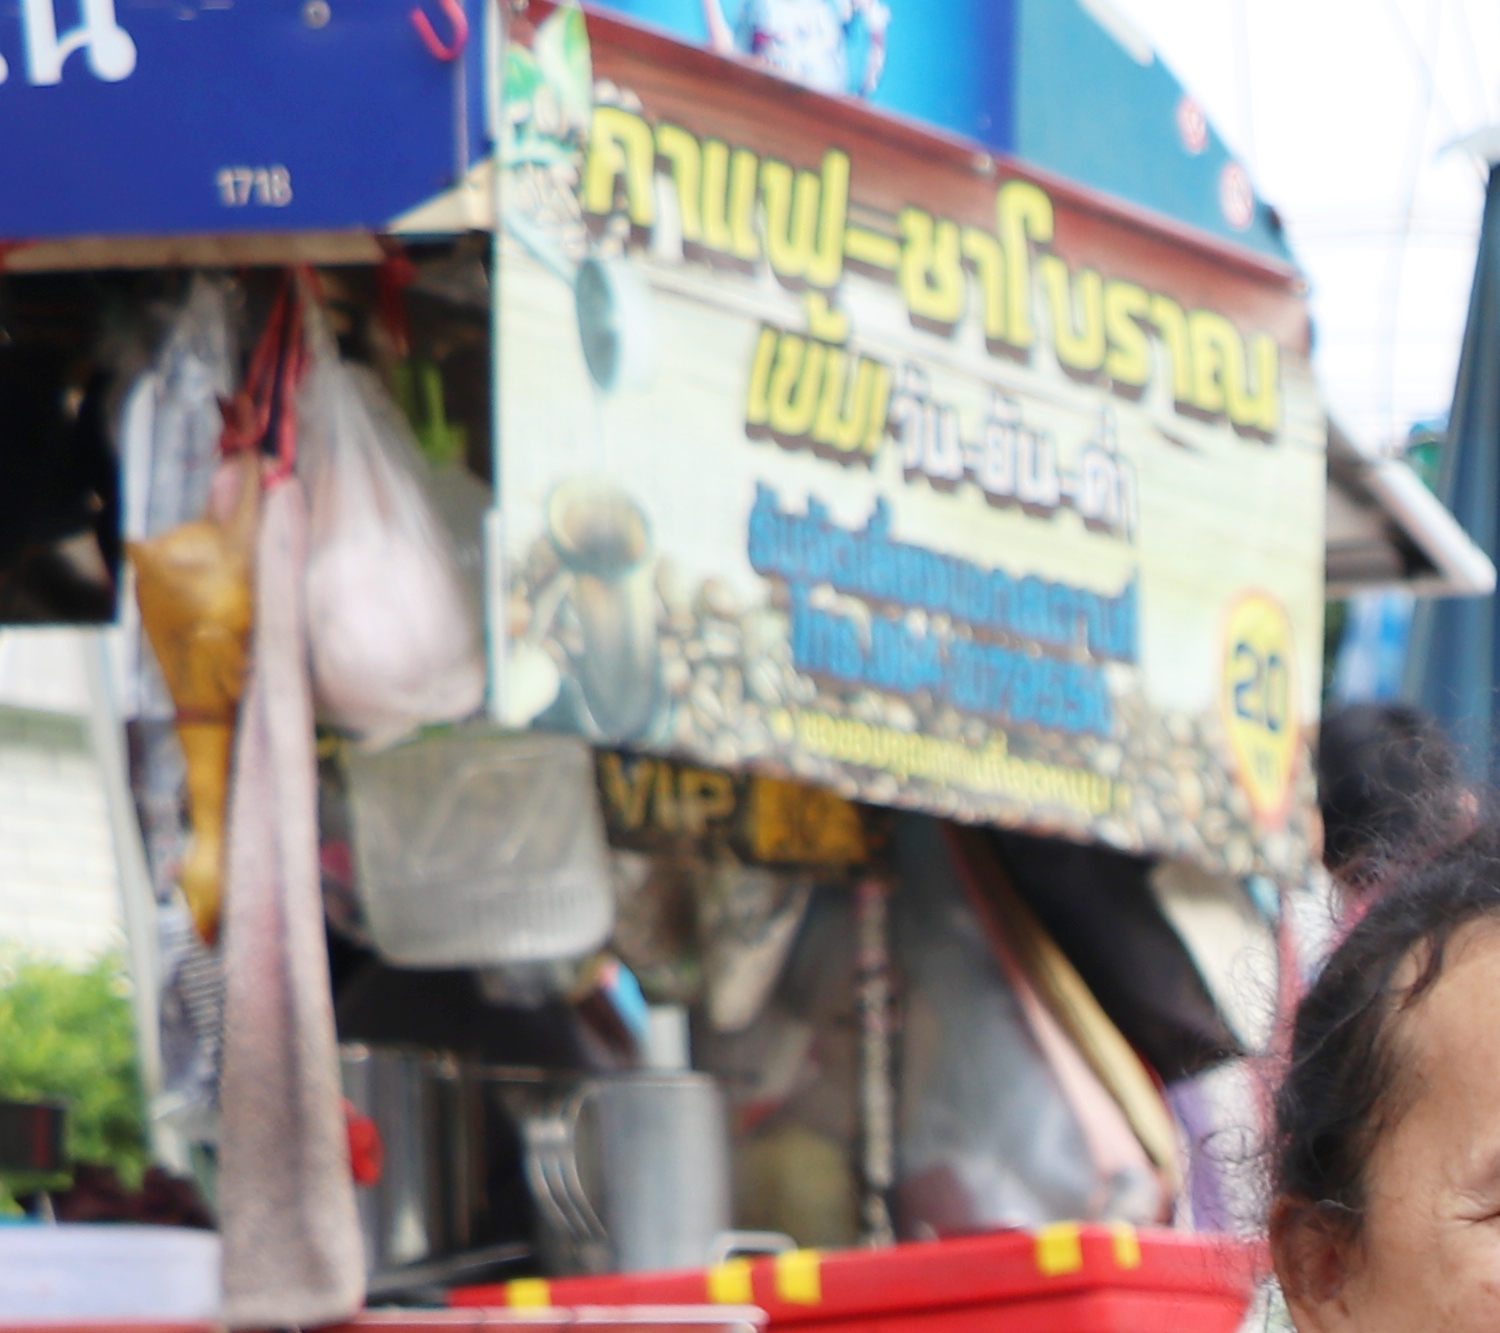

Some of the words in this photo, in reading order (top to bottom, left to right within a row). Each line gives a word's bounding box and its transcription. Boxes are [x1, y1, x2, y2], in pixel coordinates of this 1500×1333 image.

[0, 0, 137, 85] น
[217, 164, 292, 207] 1718
[583, 105, 1281, 433] กาแฟ-ชาโบราณ
[1233, 640, 1288, 732] 20
[602, 750, 738, 838] VIP
